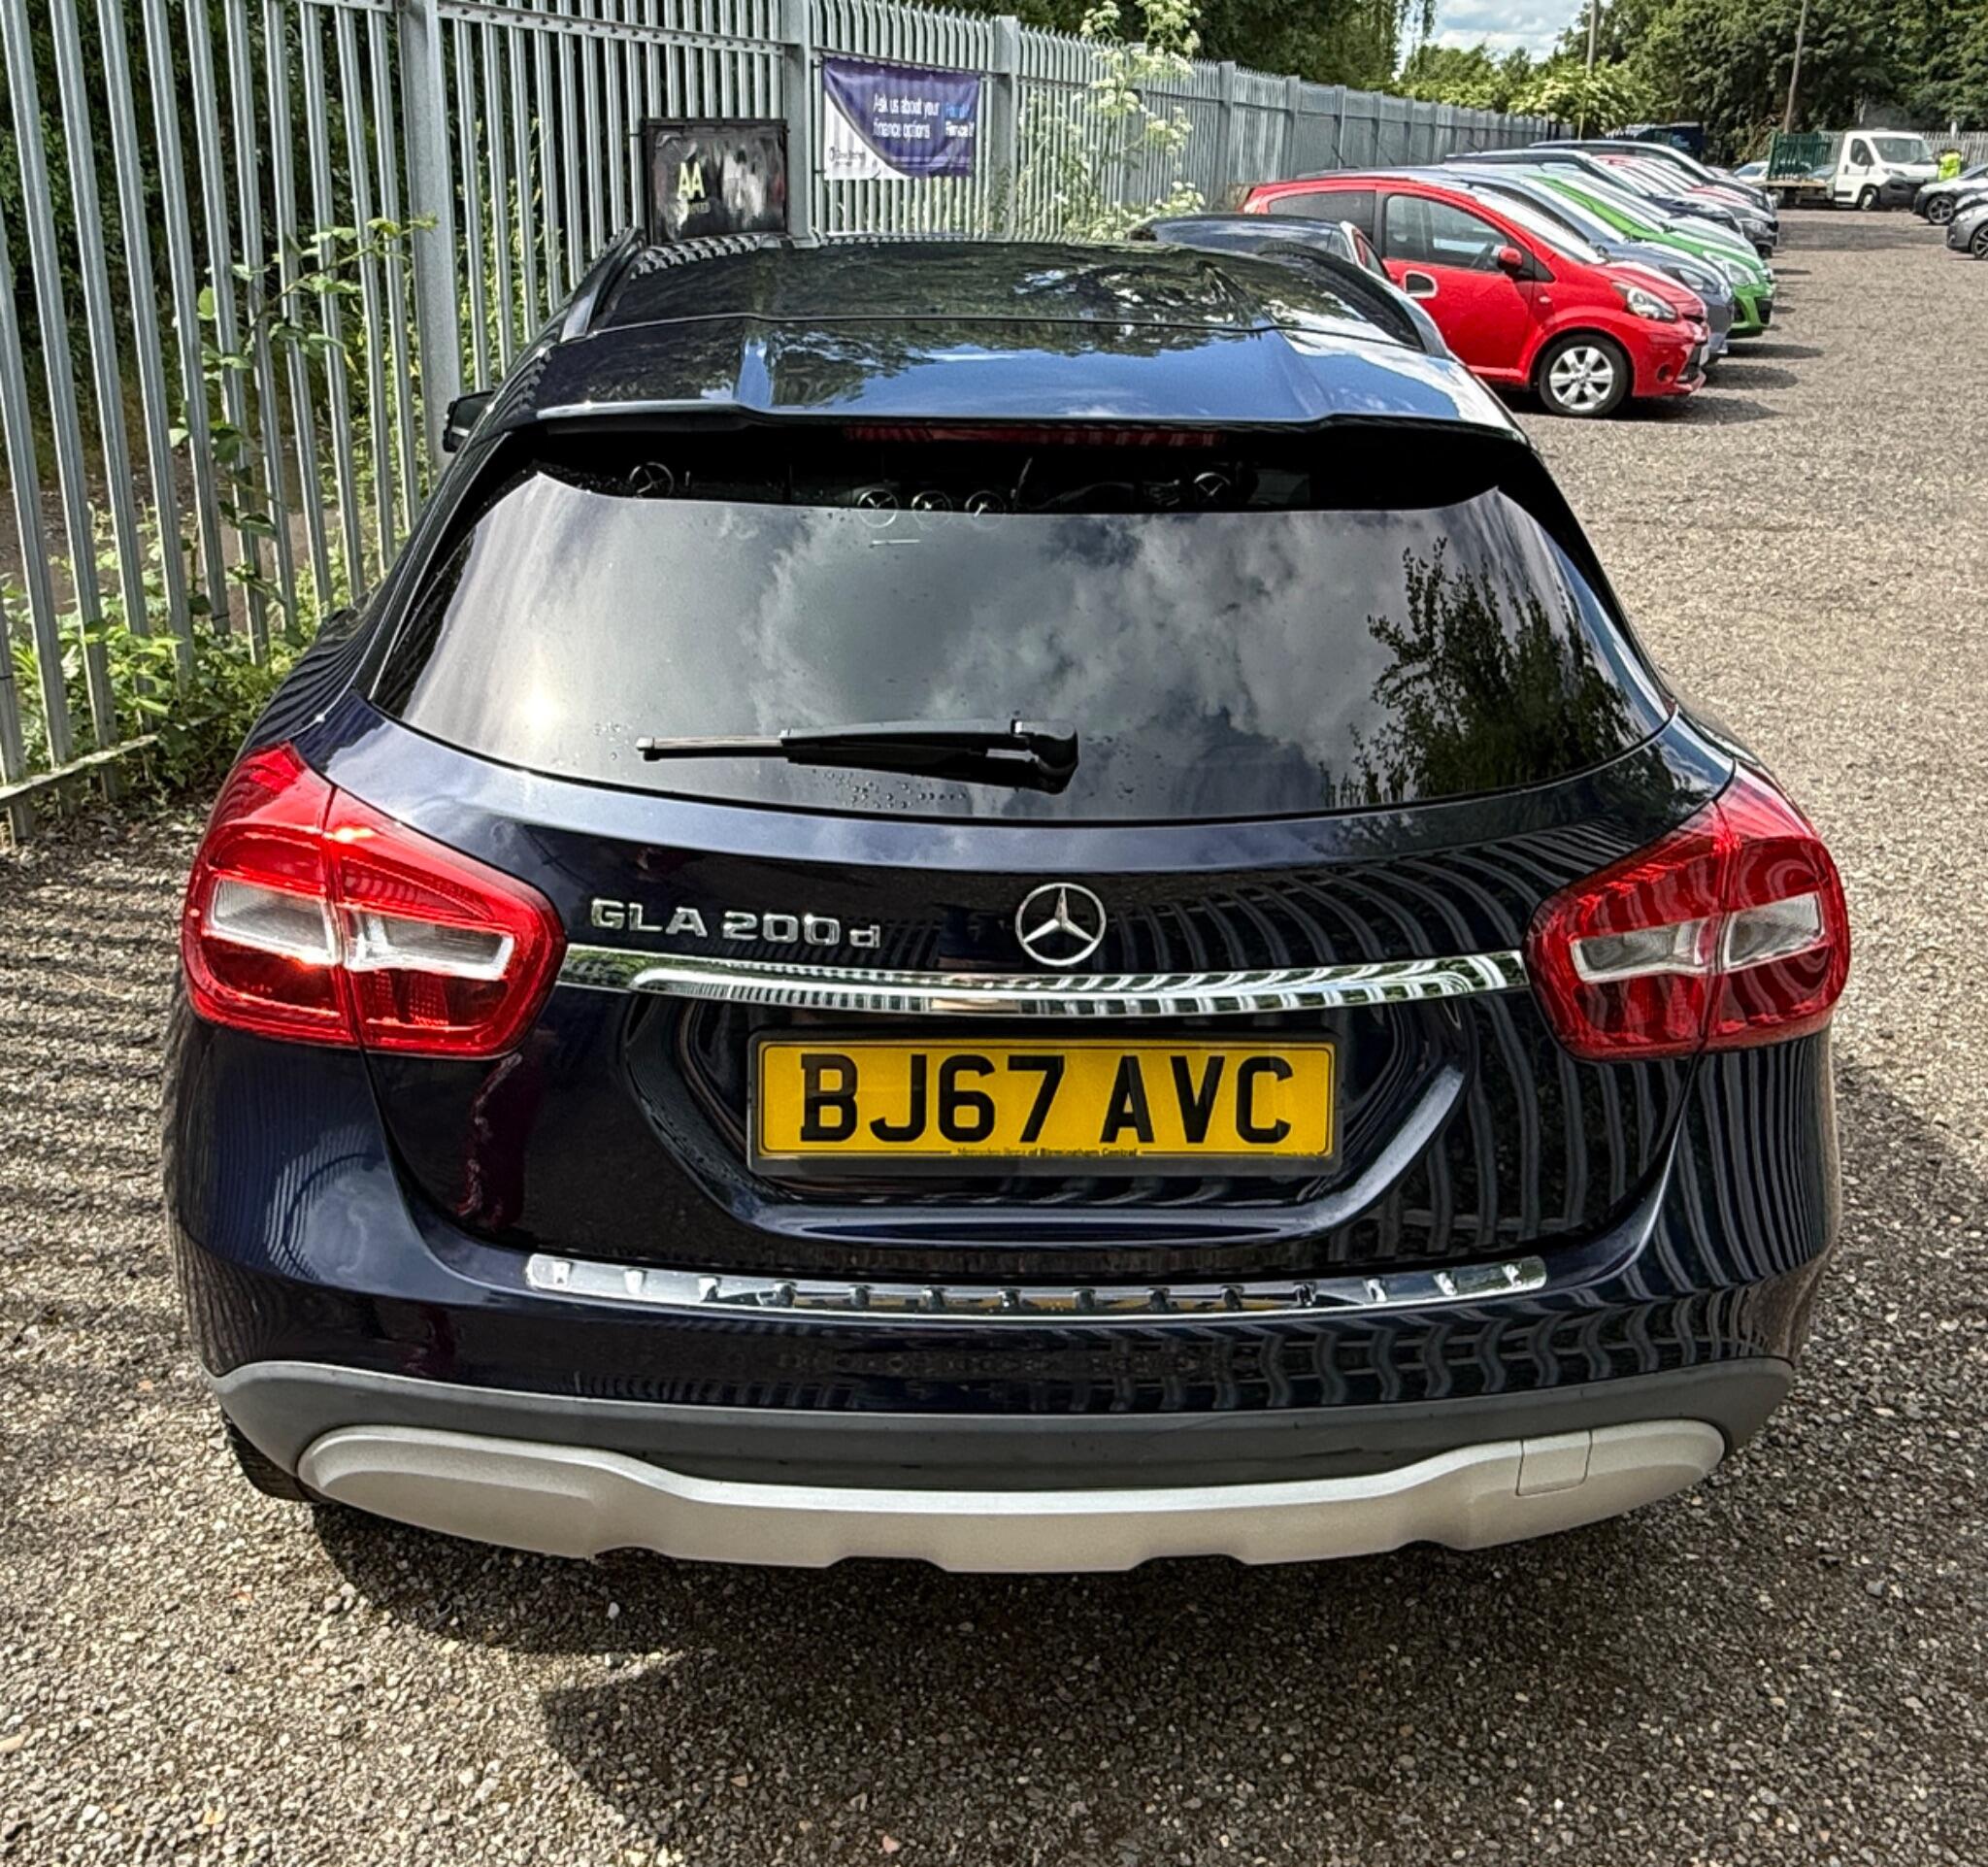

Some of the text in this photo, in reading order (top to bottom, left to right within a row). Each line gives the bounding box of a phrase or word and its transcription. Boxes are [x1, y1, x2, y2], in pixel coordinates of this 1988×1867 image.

[874, 93, 887, 113] Ask
[890, 98, 898, 114] us
[901, 95, 921, 115] about
[924, 101, 940, 119] your
[874, 117, 930, 142] finance options
[677, 161, 706, 199] AA
[590, 897, 881, 949] GLA 200 d
[800, 1053, 1294, 1144] BJ67 AVC
[1028, 1147, 1038, 1158] of
[1102, 1147, 1138, 1158] Central
